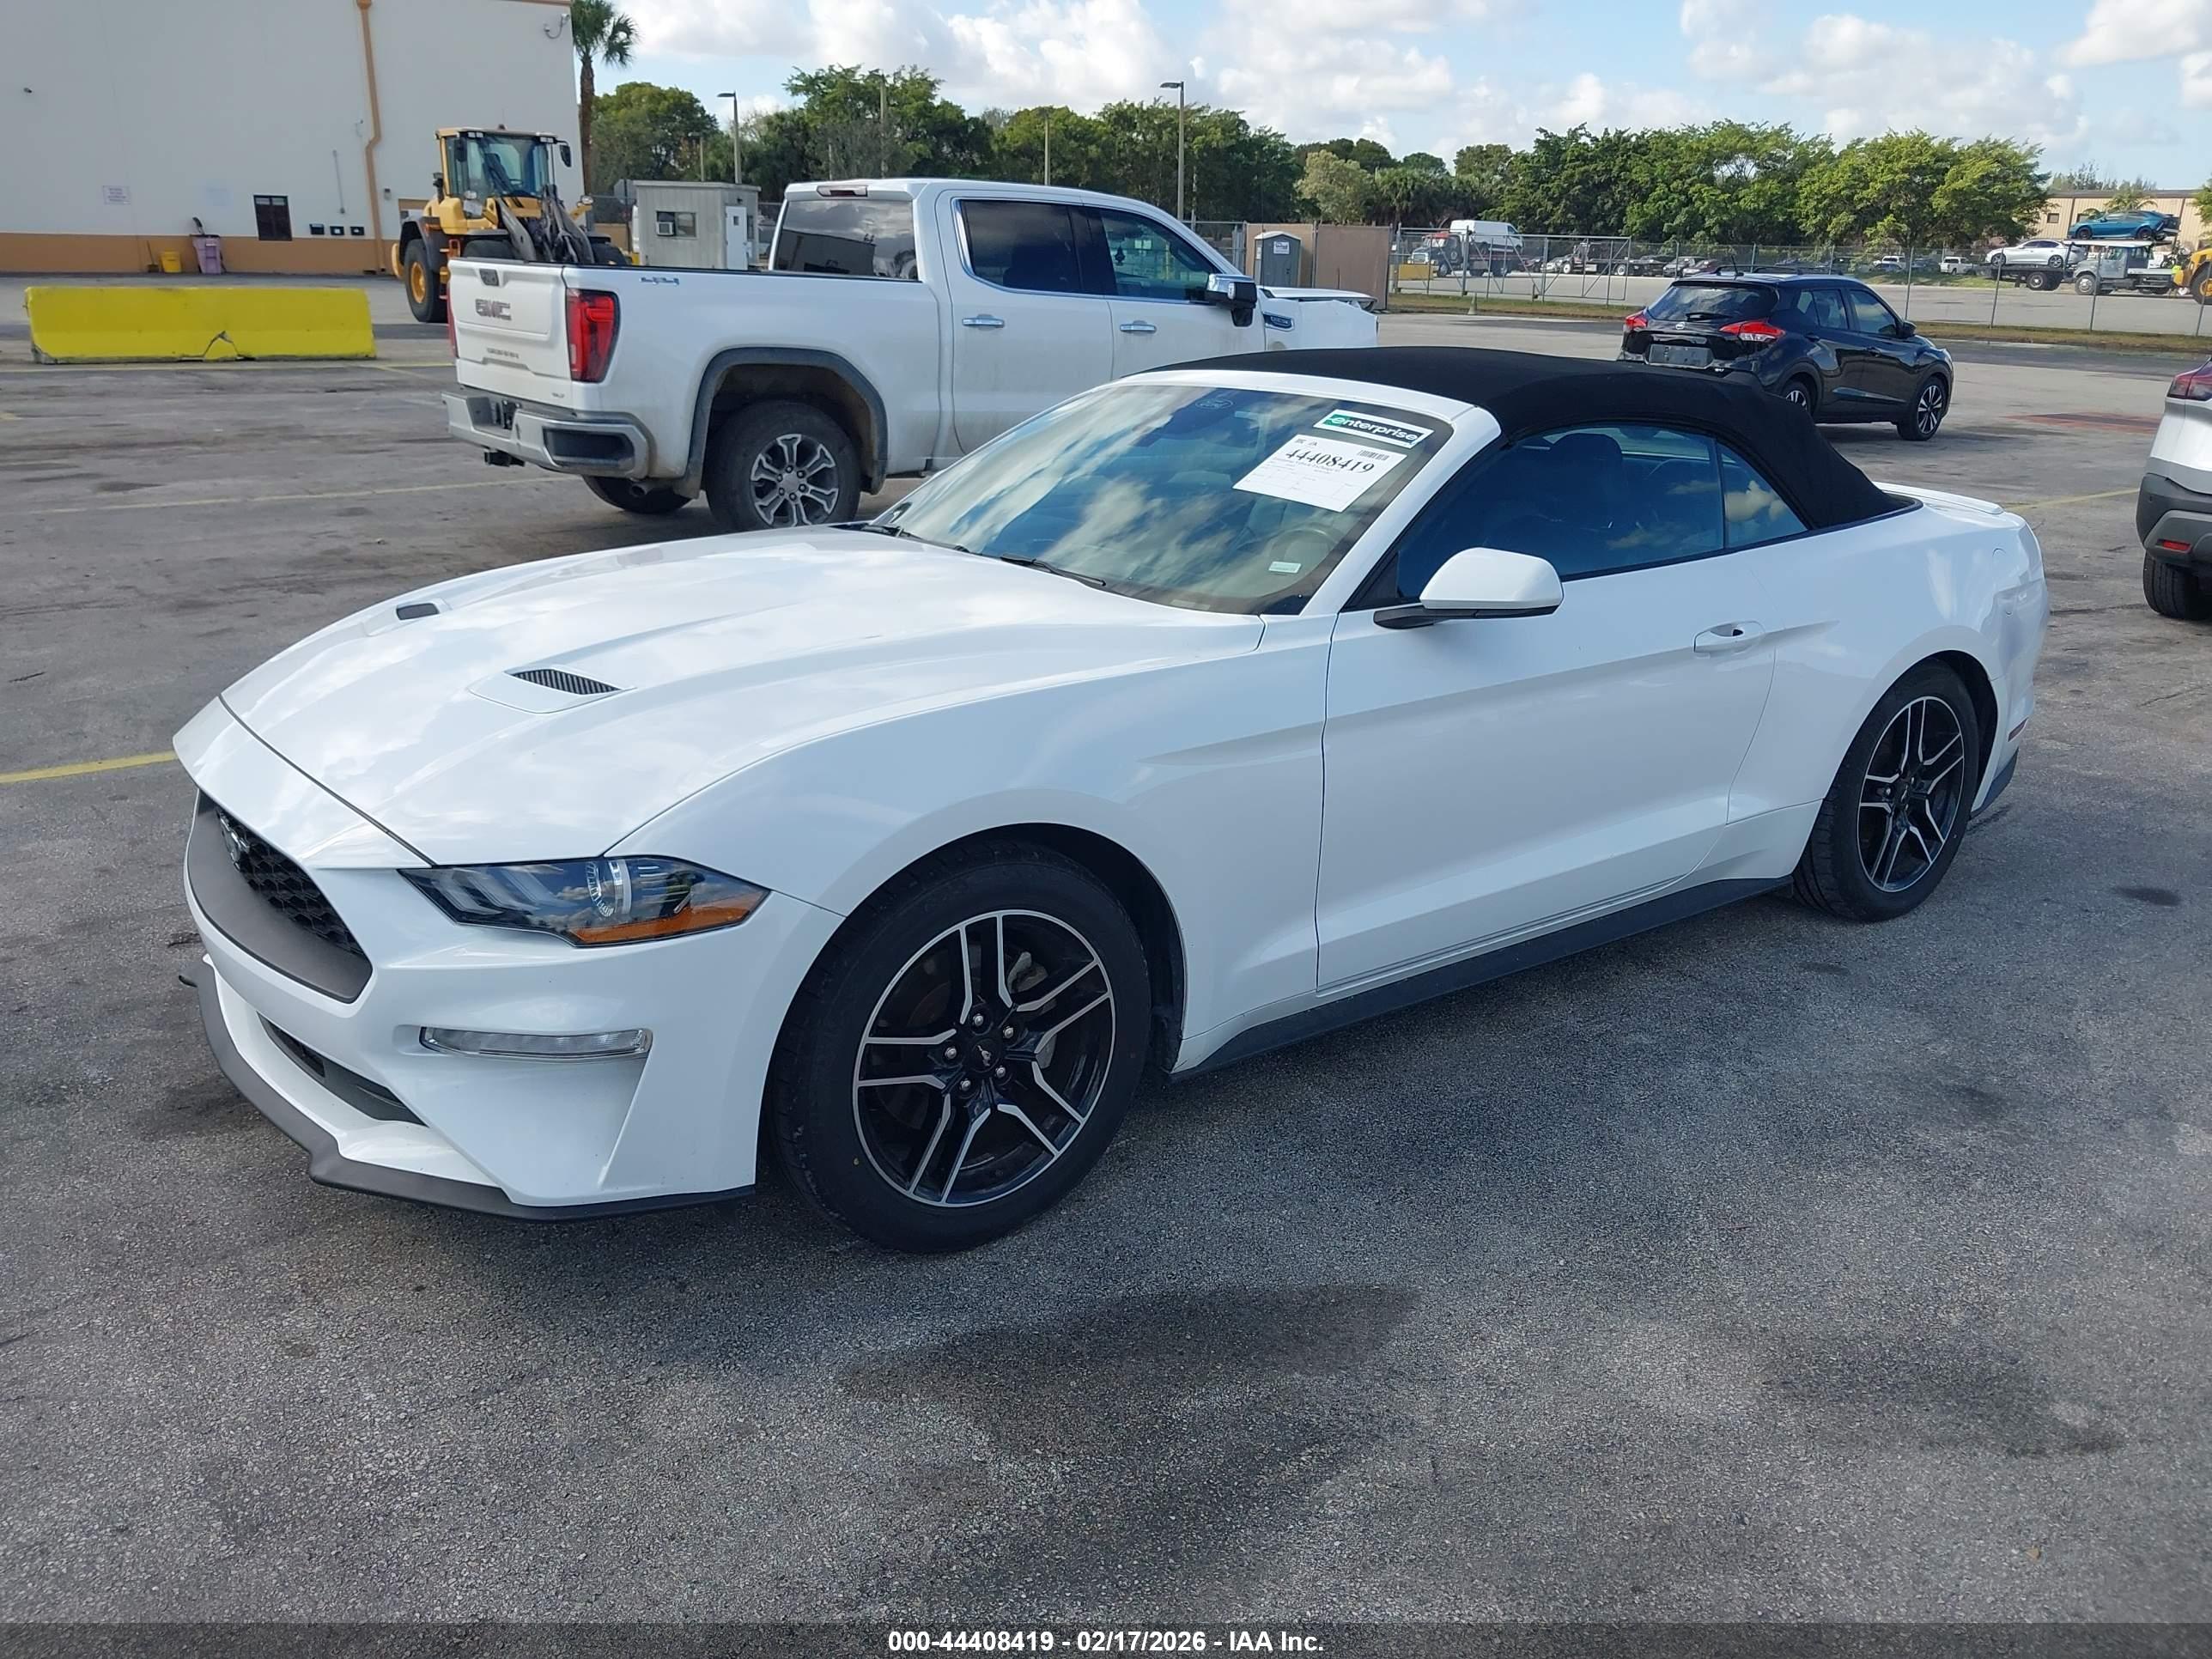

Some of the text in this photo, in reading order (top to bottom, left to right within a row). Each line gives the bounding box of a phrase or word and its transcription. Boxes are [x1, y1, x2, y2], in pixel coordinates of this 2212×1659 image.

[475, 299, 512, 321] GMC
[1326, 416, 1419, 441] enterprise
[1285, 449, 1375, 473] 44408419
